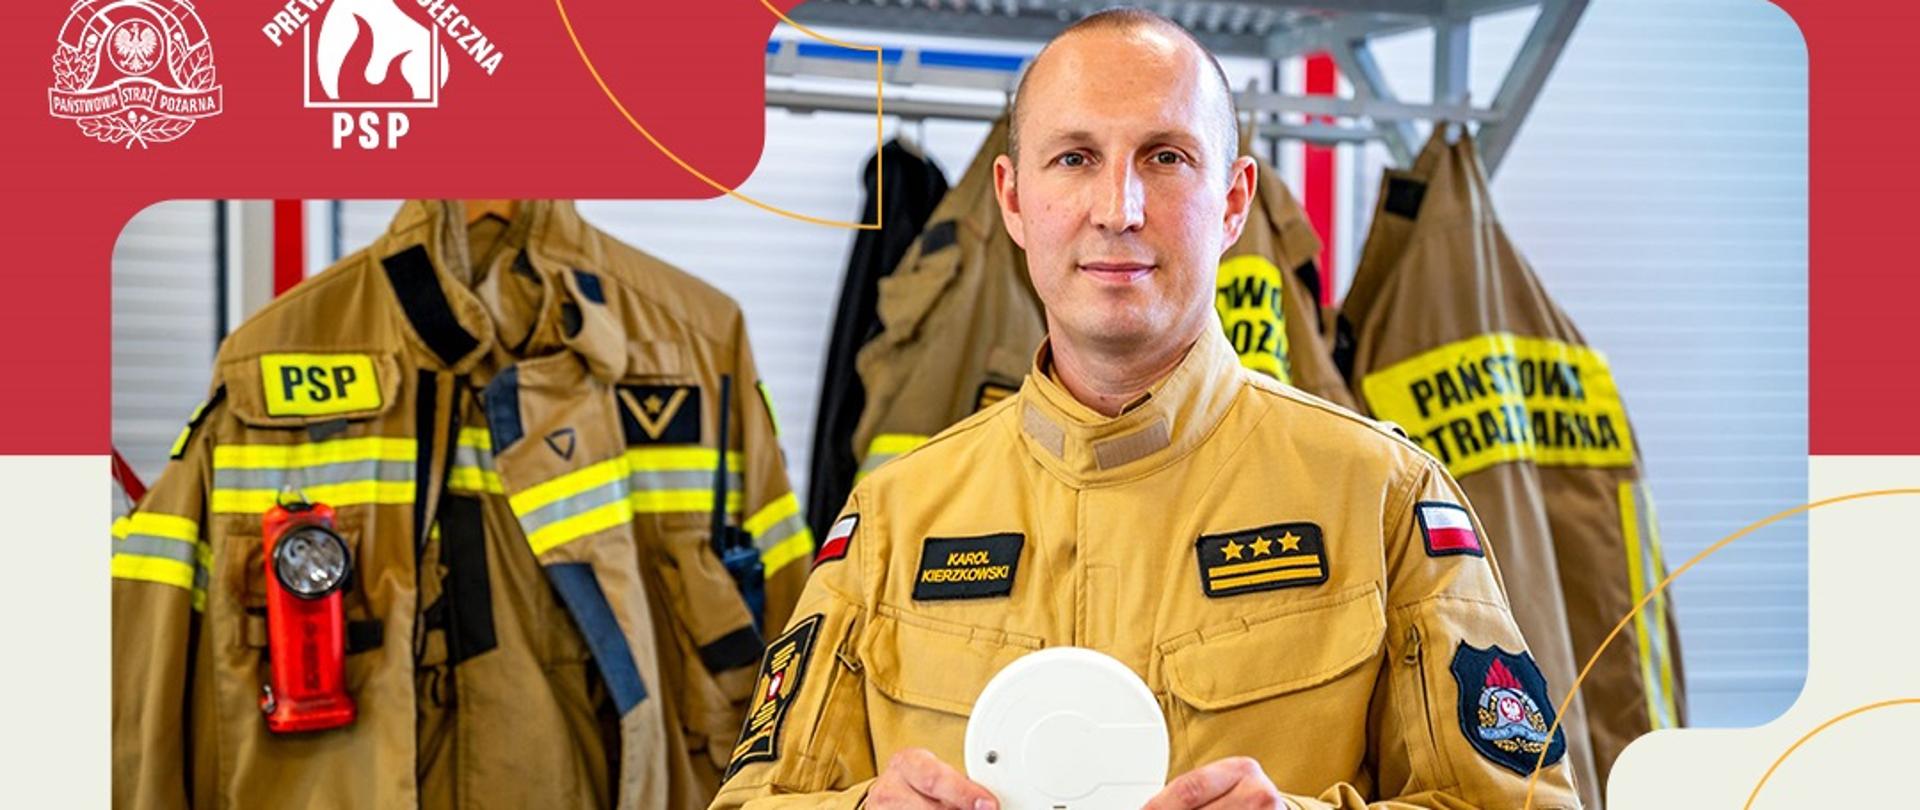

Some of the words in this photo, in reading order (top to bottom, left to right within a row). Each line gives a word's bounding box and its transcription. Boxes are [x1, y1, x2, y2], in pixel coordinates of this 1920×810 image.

[280, 365, 357, 402] PSP
[947, 551, 990, 565] KAROL
[921, 565, 1010, 582] KIERZKOWSKI
